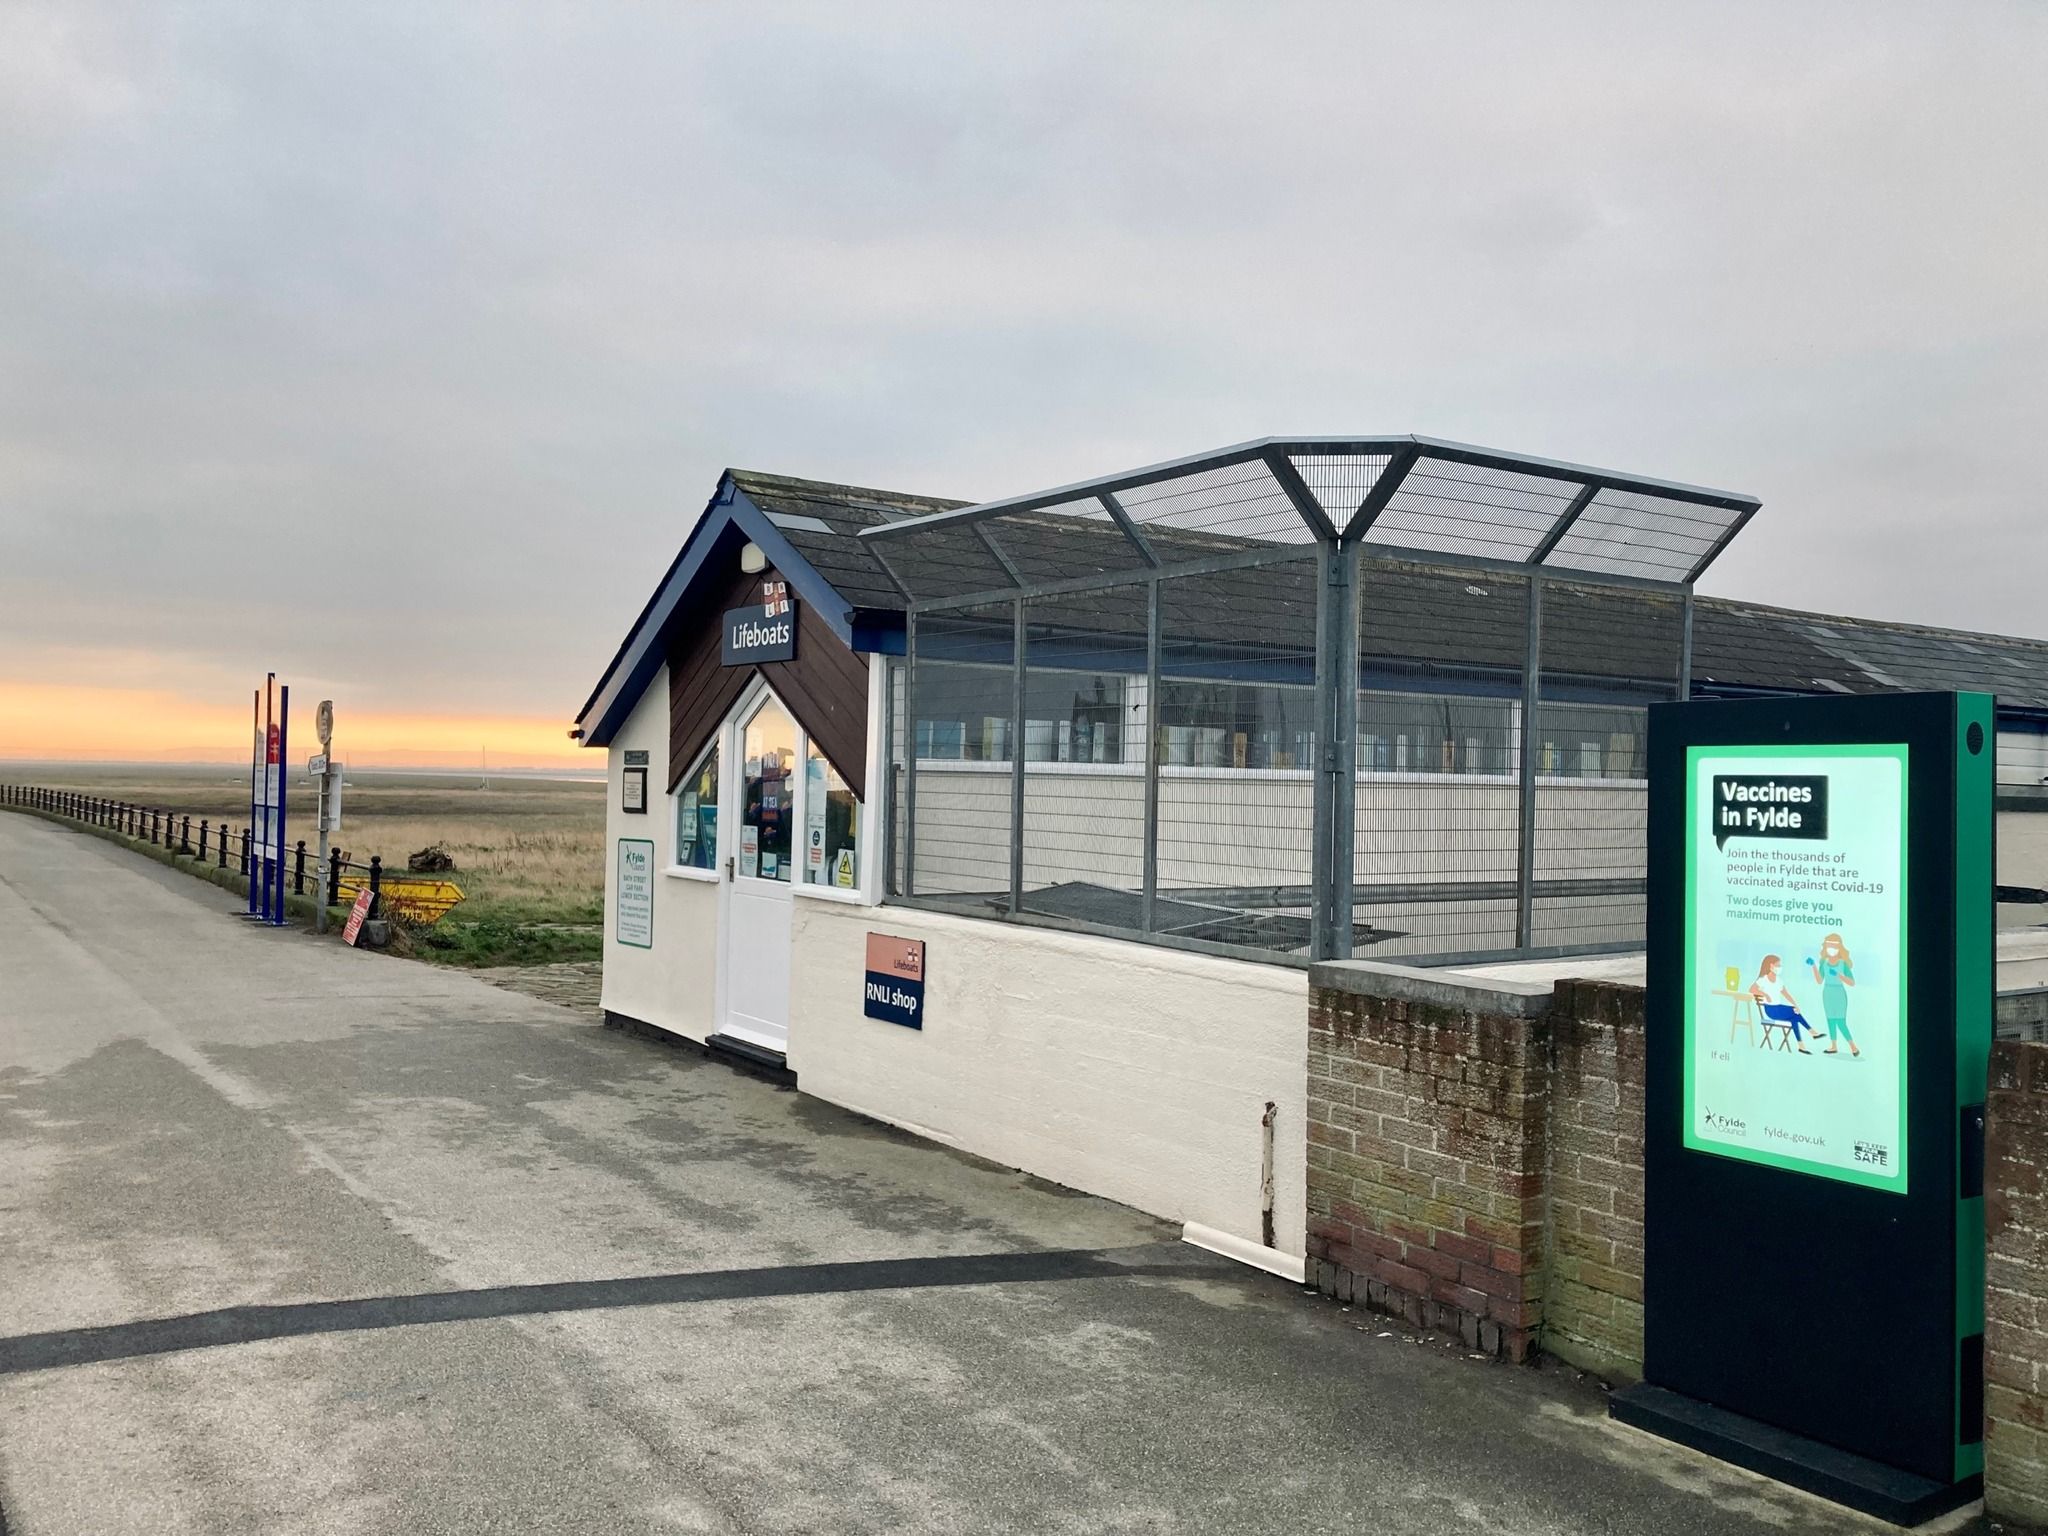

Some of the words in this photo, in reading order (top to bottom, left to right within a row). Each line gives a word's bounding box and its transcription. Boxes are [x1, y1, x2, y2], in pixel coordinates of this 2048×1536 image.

[733, 621, 789, 649] Lifeboats
[1721, 782, 1812, 803] Vaccines
[1722, 806, 1741, 826] in
[1747, 807, 1802, 831] Fylde
[632, 852, 646, 864] Fylde
[1727, 849, 1748, 859] Join
[1751, 850, 1769, 860] the
[1771, 850, 1830, 863] thousands
[1833, 852, 1846, 864] of
[1727, 862, 1763, 874] people
[1766, 863, 1776, 874] in
[1779, 864, 1809, 877] Fylde
[1812, 866, 1836, 877] that
[1839, 869, 1859, 878] are
[1727, 876, 1784, 888] vaccinated
[1787, 880, 1828, 892] against
[1831, 881, 1883, 894] Covid-19
[1726, 895, 1749, 905] Two
[1752, 896, 1783, 908] doses
[1785, 898, 1809, 911] give
[1811, 902, 1833, 913] you
[1726, 909, 1780, 921] maximum
[1783, 913, 1843, 927] protection
[894, 960, 919, 973] Lifeboats
[866, 982, 890, 1004] RNLI
[892, 988, 917, 1015] shop
[1718, 1125, 1746, 1136] Council
[1719, 1116, 1746, 1129] Fylde
[1764, 1127, 1826, 1146] fylde.gov.uk
[1854, 1151, 1888, 1166] SAFE
